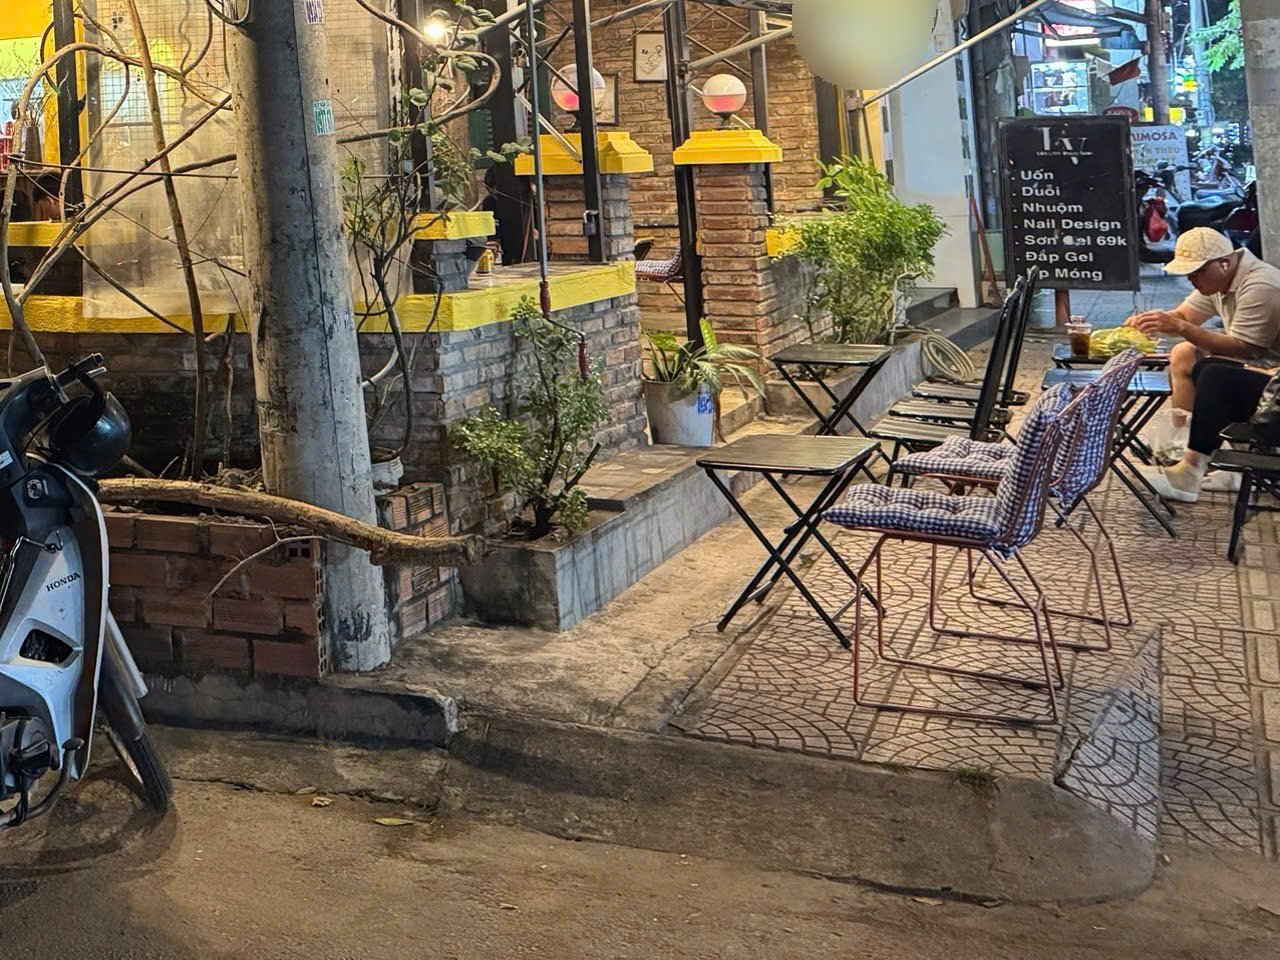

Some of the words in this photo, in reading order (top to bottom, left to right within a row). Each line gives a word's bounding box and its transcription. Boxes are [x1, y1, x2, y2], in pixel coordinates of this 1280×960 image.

[1020, 168, 1054, 181] Uốn
[1022, 202, 1084, 215] Nhuộm
[1023, 218, 1056, 229] Nail
[1061, 218, 1122, 232] Design
[1024, 235, 1057, 246] Sơn
[1063, 235, 1092, 246] el
[1096, 235, 1128, 247] 69k
[1064, 251, 1094, 262] Gel
[1054, 267, 1103, 282] Móng
[45, 572, 81, 592] HONDA
